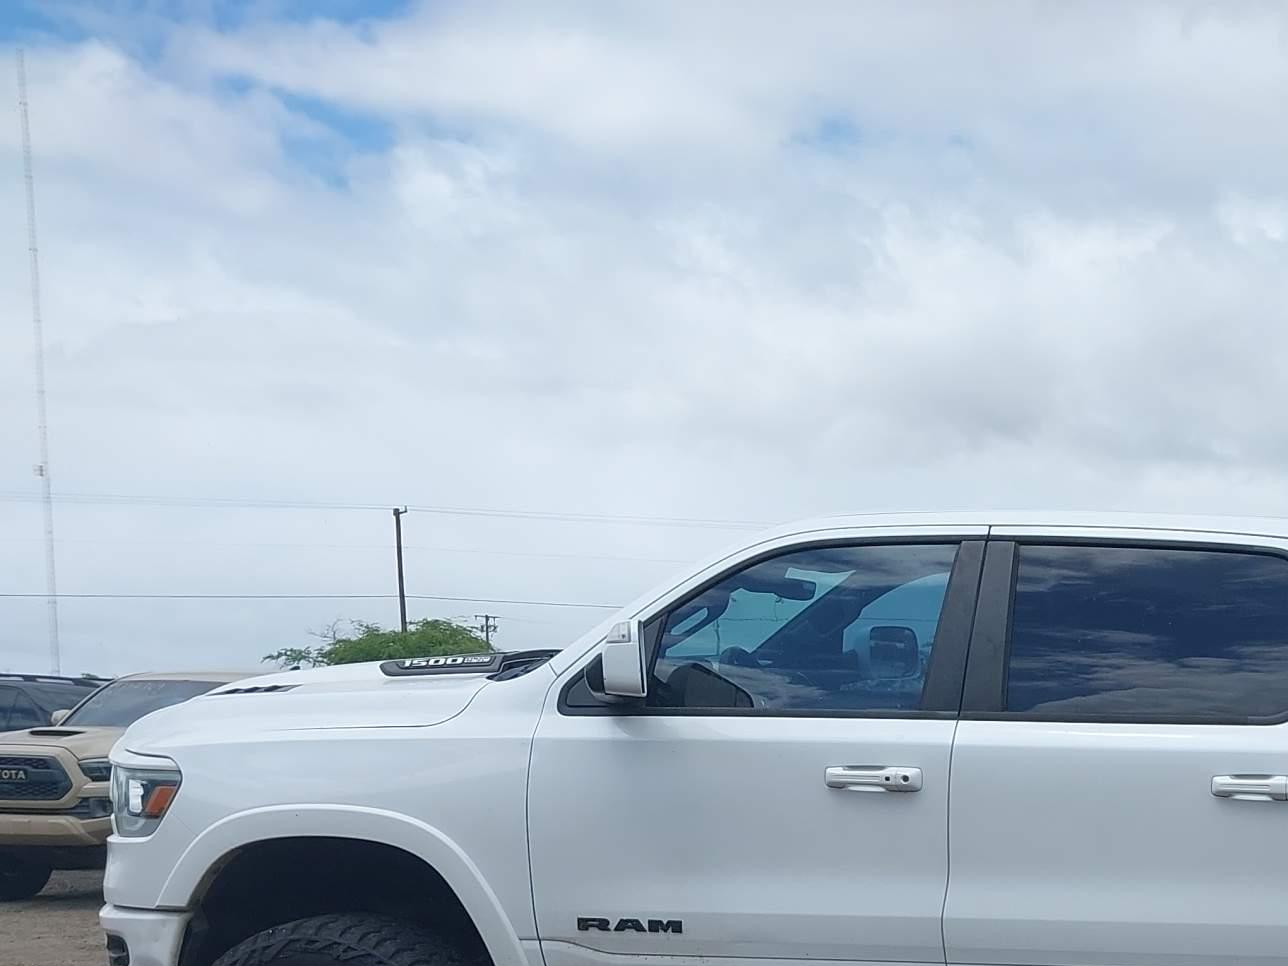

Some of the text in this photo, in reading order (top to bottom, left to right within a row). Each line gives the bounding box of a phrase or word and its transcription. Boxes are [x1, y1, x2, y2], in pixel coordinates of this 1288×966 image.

[403, 657, 464, 667] 1500
[0, 770, 26, 779] OTA
[577, 917, 683, 933] RAM
